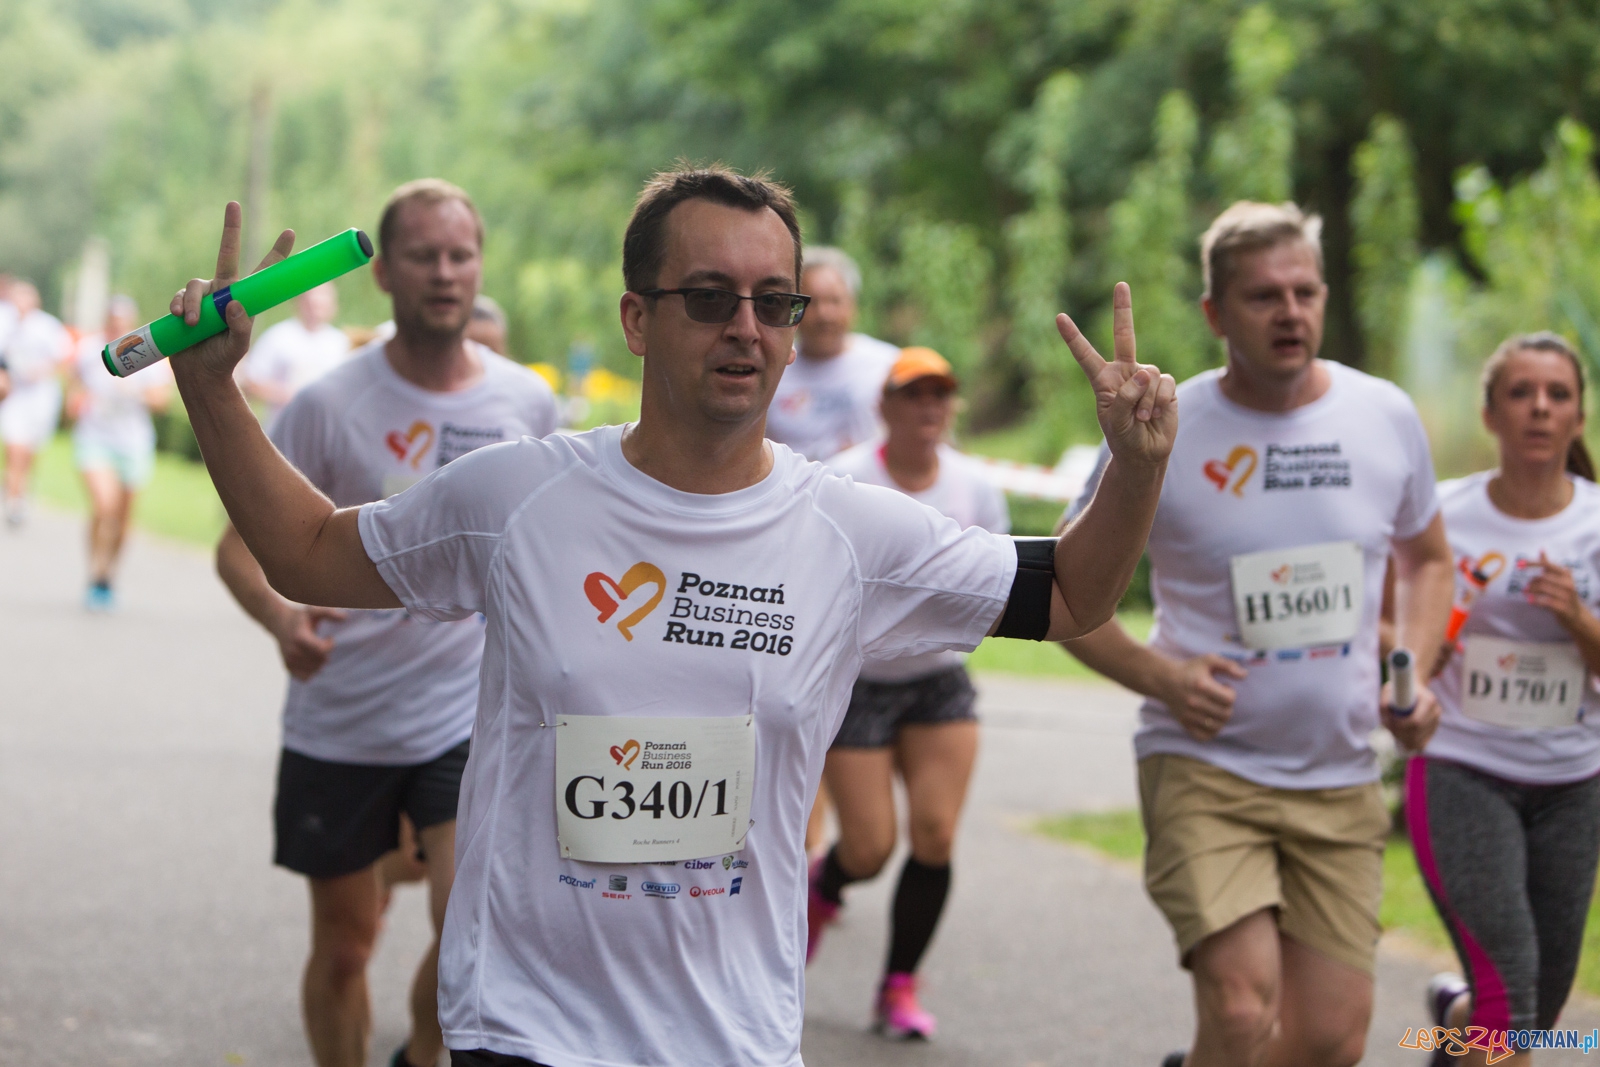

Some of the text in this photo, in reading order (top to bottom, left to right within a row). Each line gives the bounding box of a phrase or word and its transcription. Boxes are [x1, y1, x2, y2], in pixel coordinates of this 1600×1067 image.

[677, 572, 784, 604] Poznań
[1244, 583, 1353, 624] H360/1
[669, 597, 795, 631] Business
[662, 621, 794, 657] Run 2016
[644, 741, 687, 750] Poznań
[643, 751, 692, 760] Business
[641, 761, 692, 769] Run 2016
[564, 775, 729, 820] G340/1
[684, 859, 716, 870] ciber
[645, 883, 677, 892] wavin
[702, 887, 725, 896] VEOLIA
[602, 892, 632, 900] SEAT
